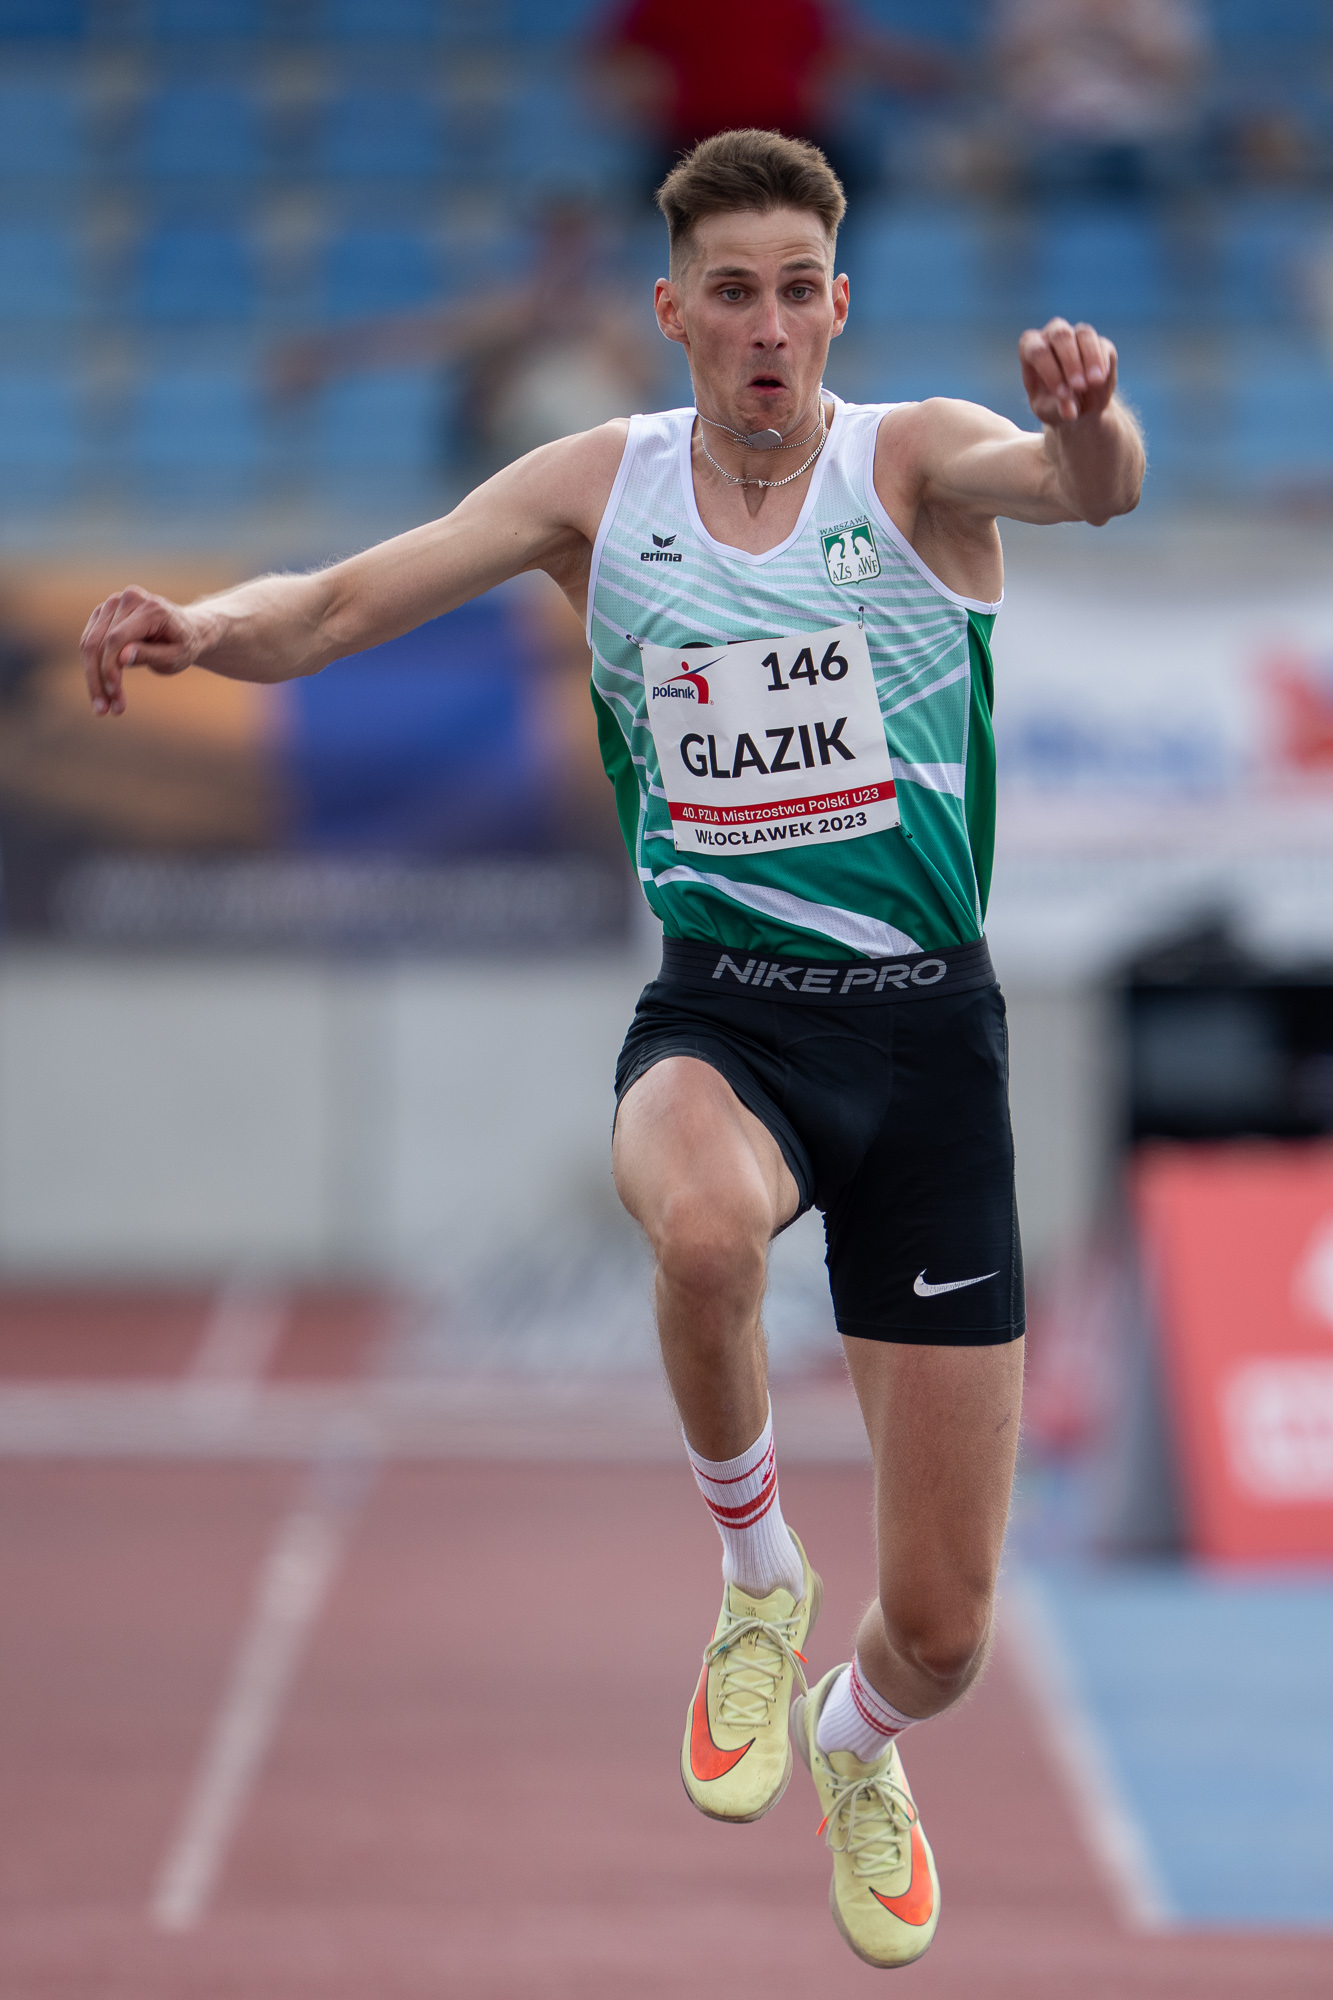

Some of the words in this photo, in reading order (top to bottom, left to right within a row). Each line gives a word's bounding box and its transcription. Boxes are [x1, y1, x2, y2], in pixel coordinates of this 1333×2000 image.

[820, 515, 869, 535] WARSZAWA
[640, 550, 682, 562] erima
[832, 562, 853, 581] AZS
[858, 556, 878, 576] AWF
[761, 640, 849, 691] 146
[652, 684, 696, 700] polanik
[680, 716, 856, 778] GLAZIK
[682, 807, 698, 820] 40.
[699, 809, 720, 822] PZLA
[722, 802, 806, 823] Mistrzostwa
[809, 793, 850, 812] Polski
[852, 787, 880, 804] U23
[695, 821, 815, 846] WŁOCŁAWEK
[818, 811, 868, 834] 2023
[711, 954, 839, 994] NIKE
[839, 958, 947, 994] PRO
